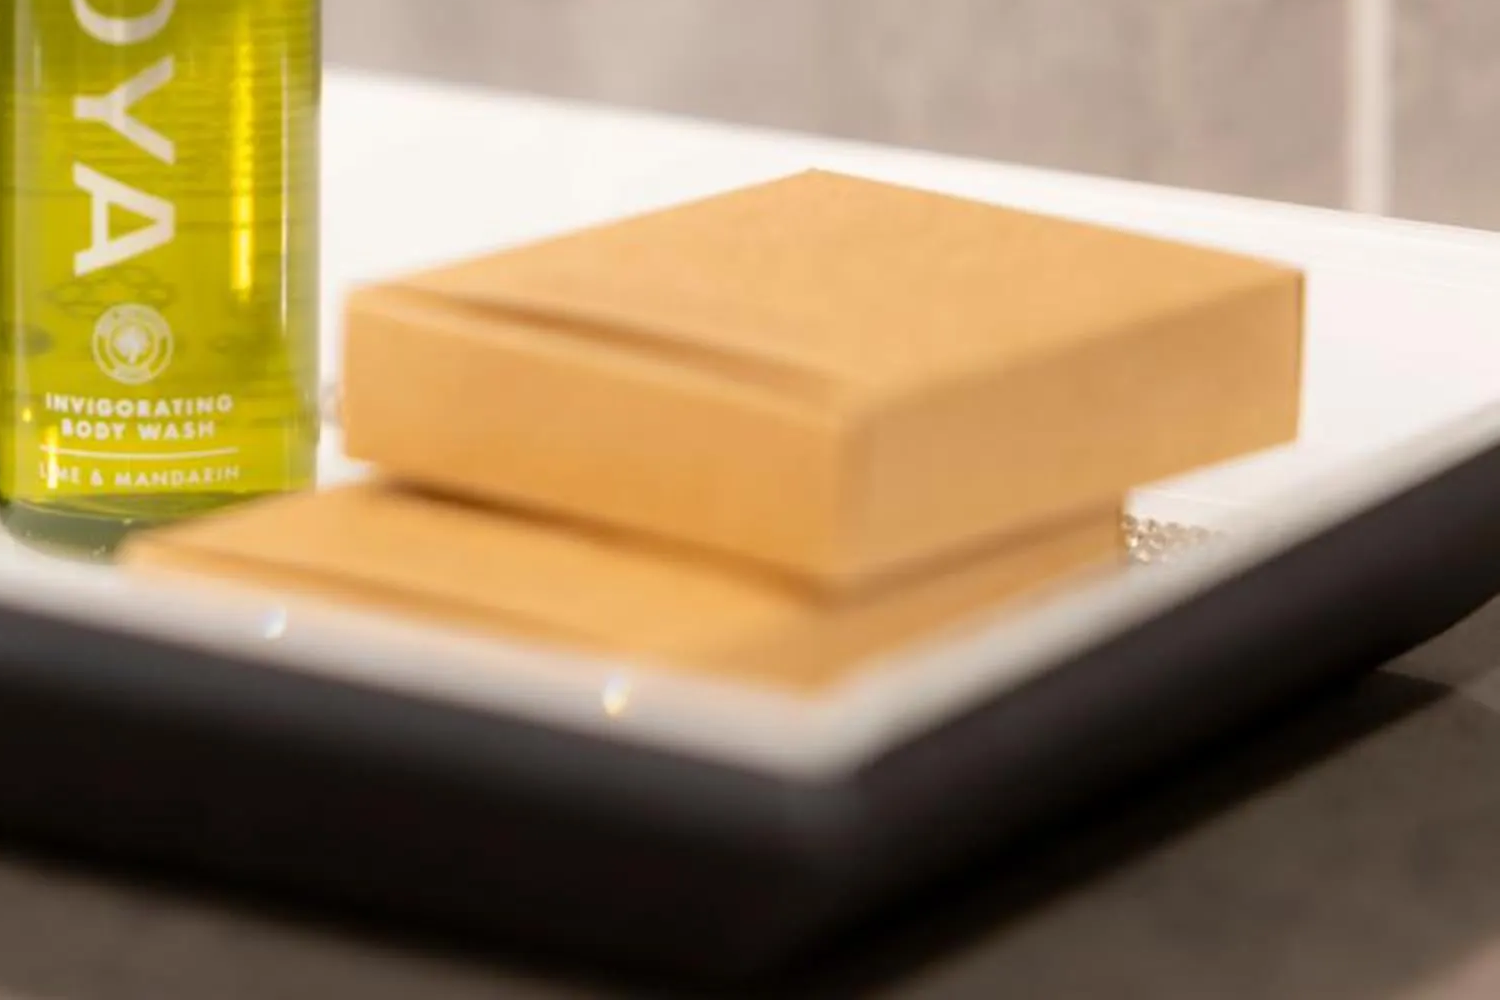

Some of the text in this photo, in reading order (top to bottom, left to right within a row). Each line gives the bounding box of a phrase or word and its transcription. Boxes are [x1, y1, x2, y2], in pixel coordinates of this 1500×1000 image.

[45, 392, 233, 418] INVIGORATING
[60, 419, 216, 441] BODY WASH
[115, 455, 240, 487] MANDARIN
